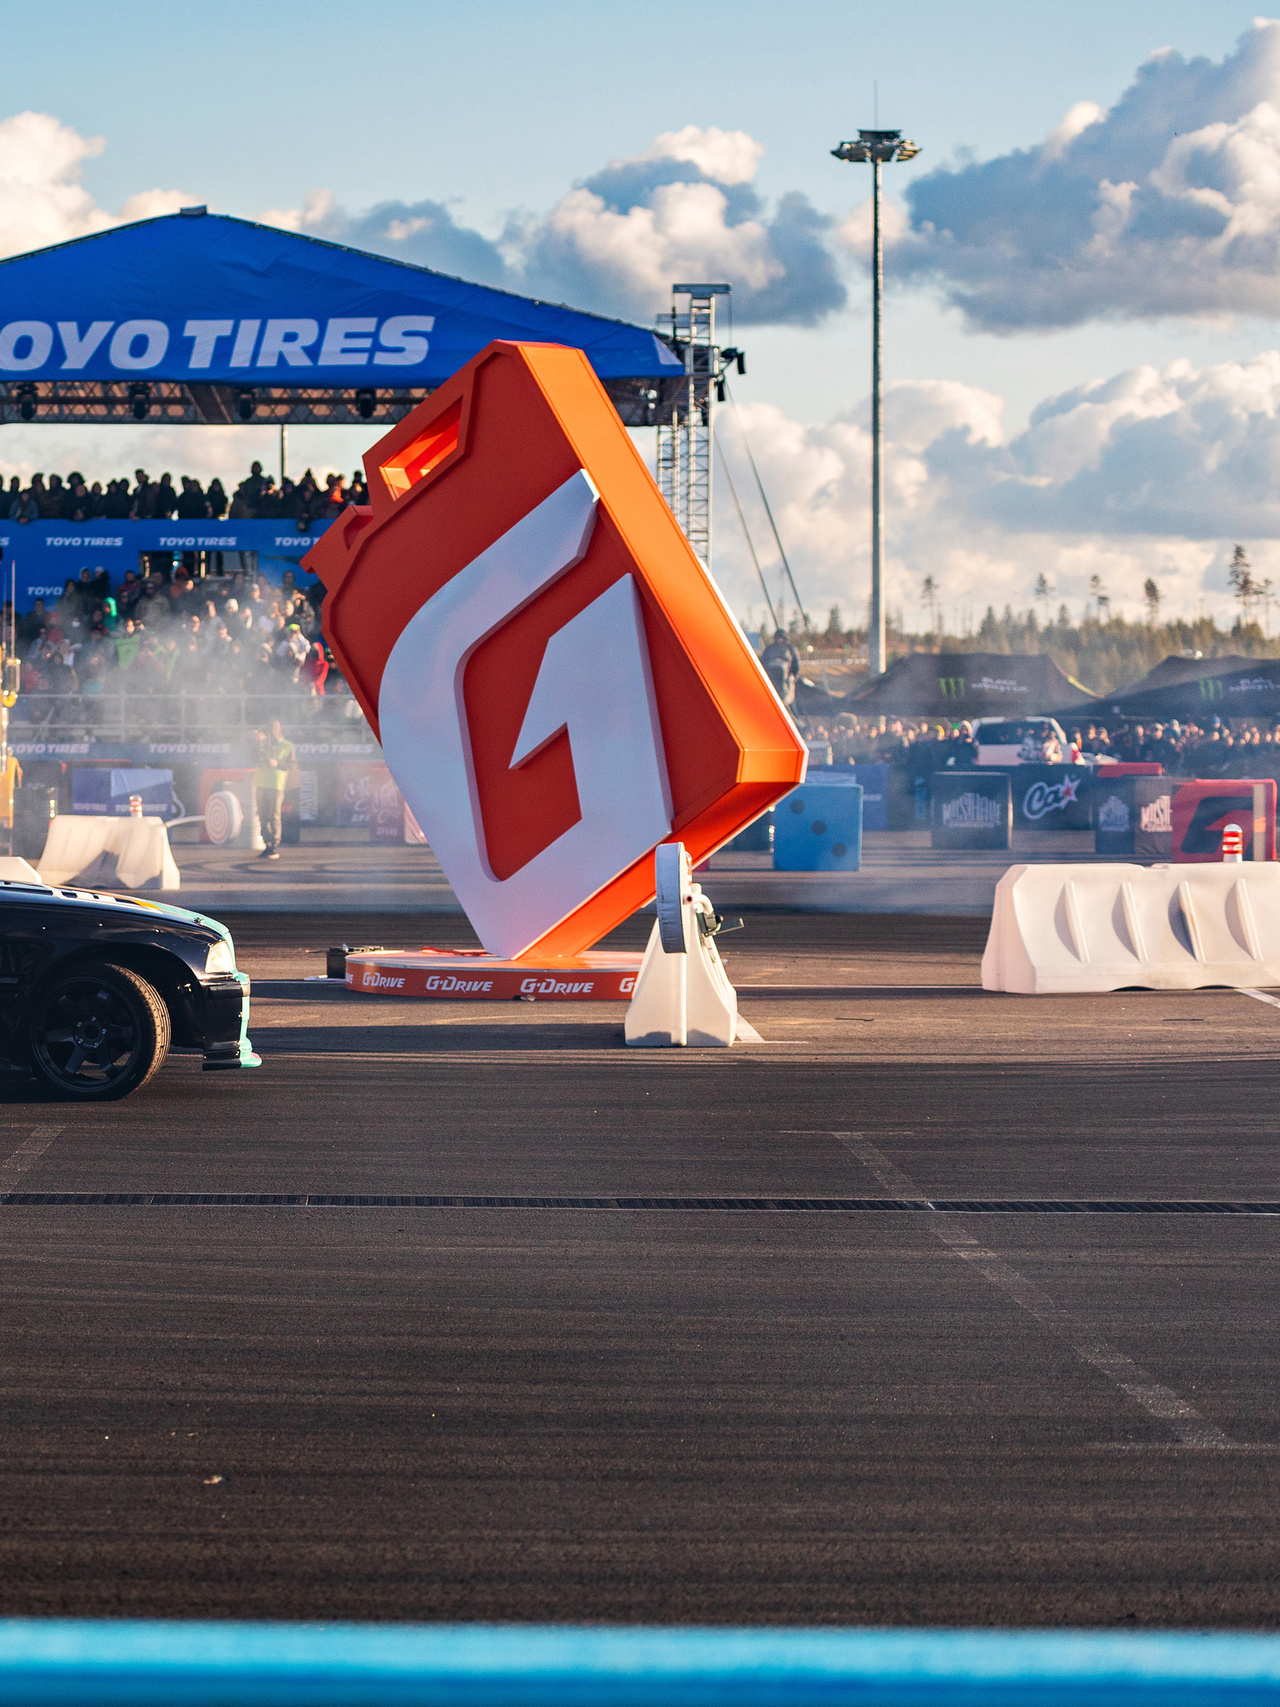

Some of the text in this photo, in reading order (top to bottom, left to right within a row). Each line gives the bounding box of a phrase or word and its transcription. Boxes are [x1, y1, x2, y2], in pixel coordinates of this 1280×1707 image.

[183, 315, 436, 369] TIRES
[46, 536, 124, 547] TOYO TIRES
[159, 536, 237, 547] TOYO TIRES
[275, 536, 311, 547] TOYO
[27, 586, 63, 596] TOYO
[47, 743, 90, 754] TIRES
[149, 743, 188, 753] TOYO
